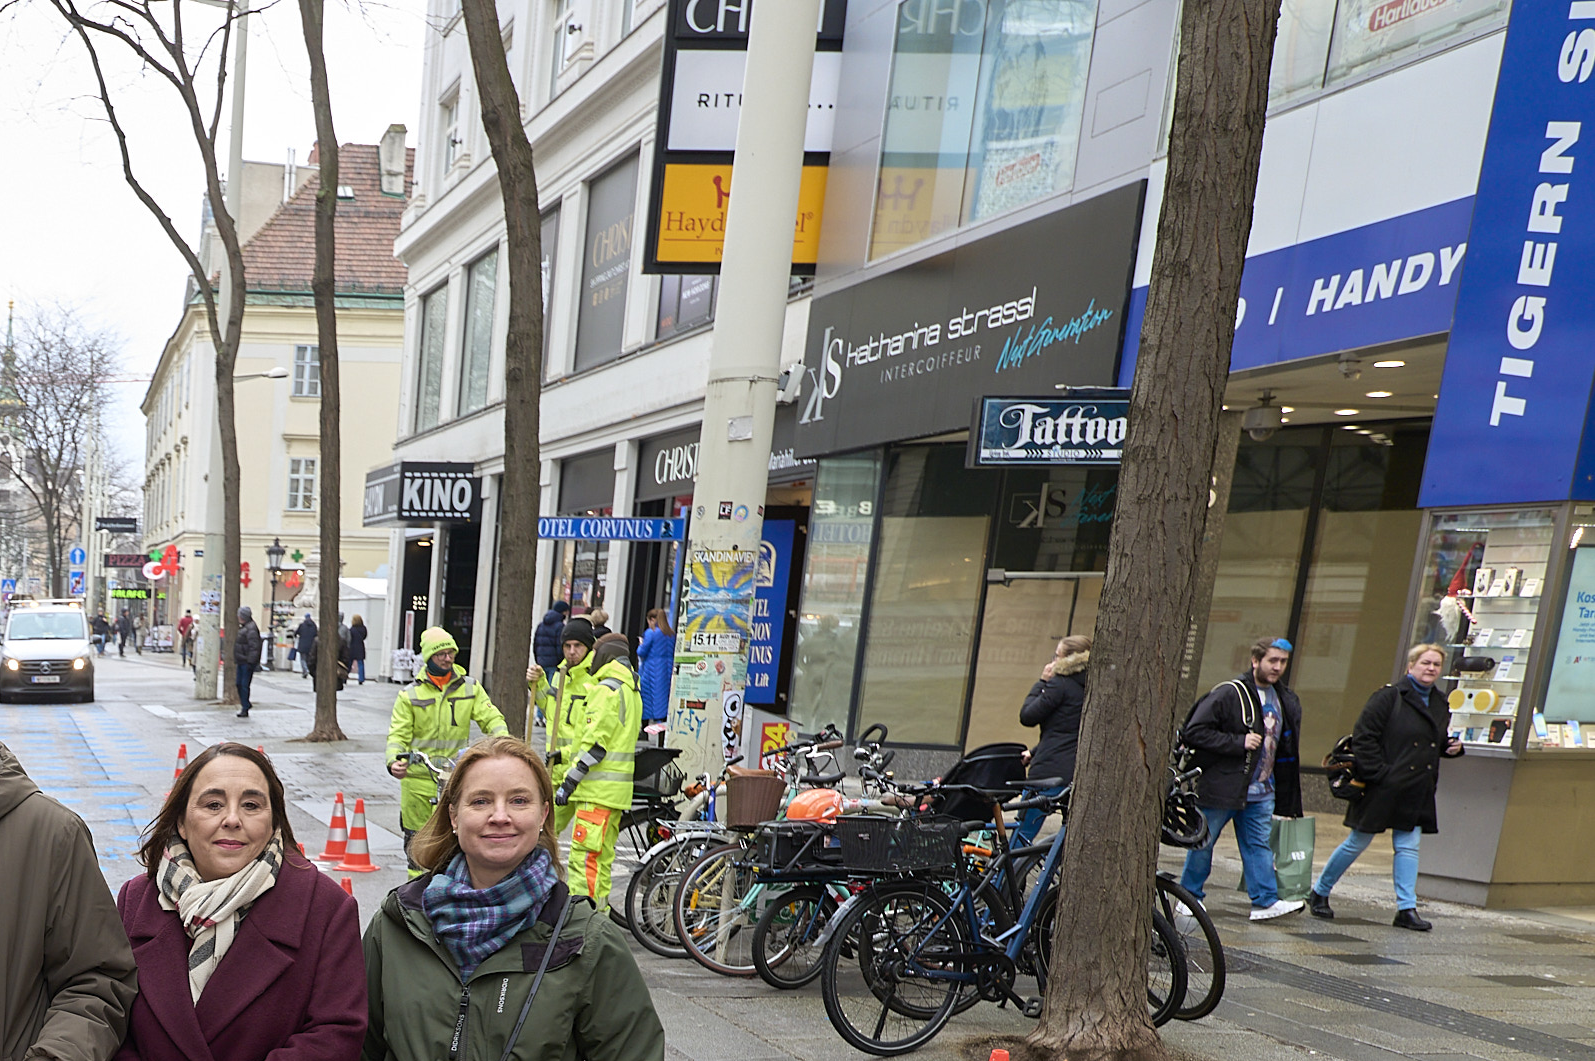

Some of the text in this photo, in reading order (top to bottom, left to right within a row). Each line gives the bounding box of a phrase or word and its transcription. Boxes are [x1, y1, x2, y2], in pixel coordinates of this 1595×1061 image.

[1306, 243, 1468, 316] HANDY
[1490, 121, 1582, 427] TIGERN
[947, 286, 1037, 340] strassl
[880, 345, 982, 383] INTERCOIFFEUR
[1000, 403, 1128, 450] Tattoo
[1047, 450, 1080, 458] STUDIO
[402, 478, 473, 512] KINO
[538, 518, 653, 538] OTEL CORVINUS
[108, 556, 146, 566] PIZZA
[693, 551, 755, 563] SKANDINAVIEN
[111, 589, 148, 599] FALAFEL
[753, 598, 770, 617] TEL
[755, 673, 769, 688] Lift
